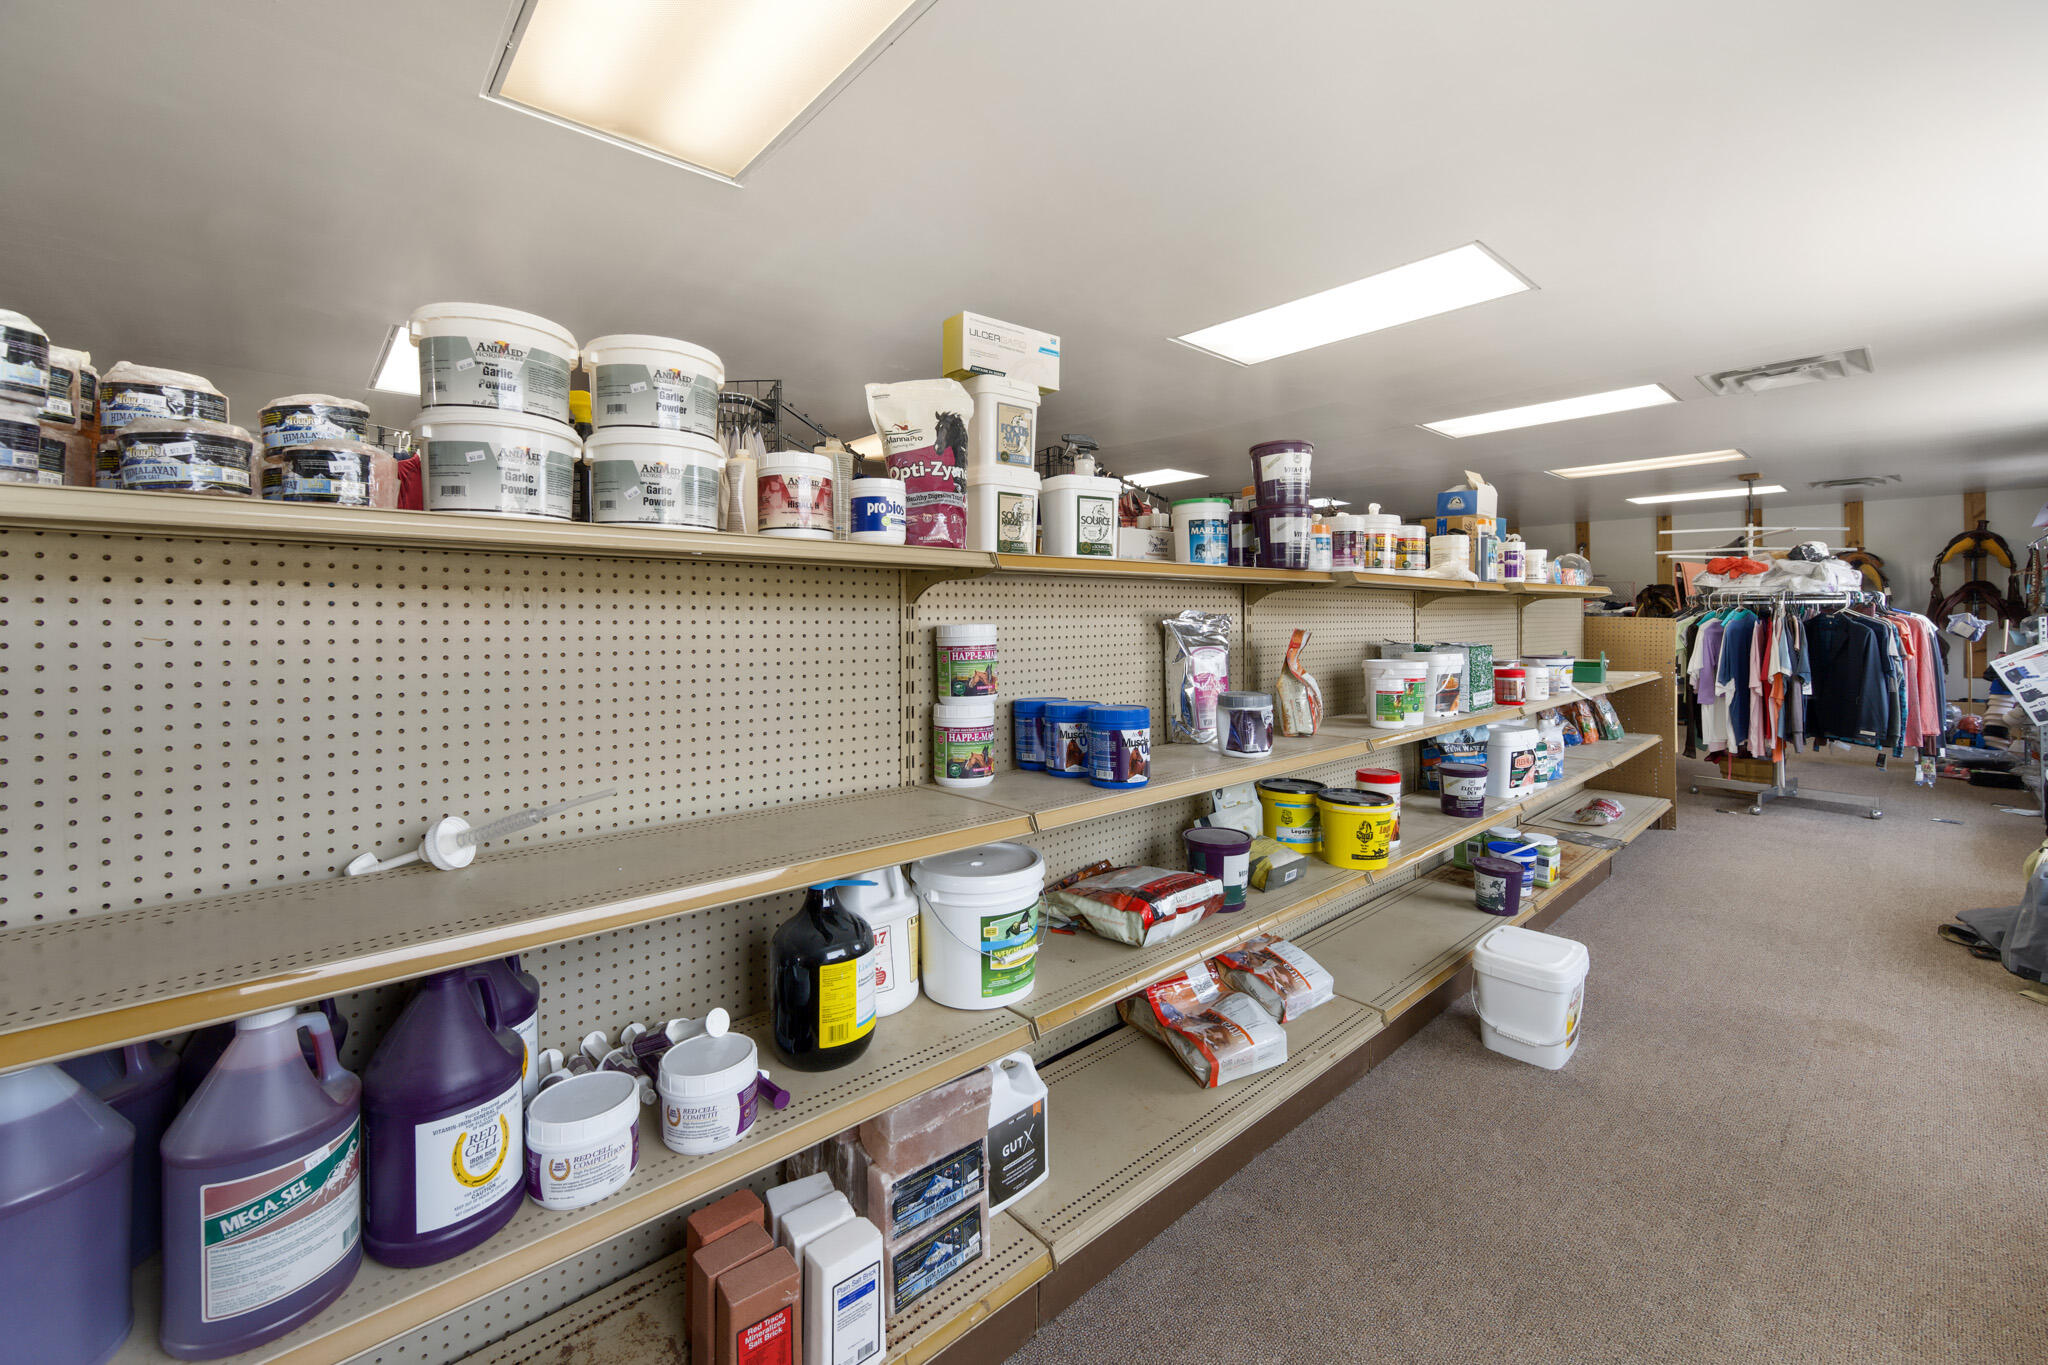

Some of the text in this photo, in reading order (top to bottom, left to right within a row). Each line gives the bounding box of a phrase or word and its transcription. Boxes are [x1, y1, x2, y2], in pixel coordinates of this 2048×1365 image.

[482, 366, 514, 379] Garlic
[478, 378, 518, 393] Powder
[659, 390, 685, 403] Garlic
[656, 402, 688, 415] Powder
[124, 465, 178, 479] HIMALAYAN
[504, 471, 534, 484] Garlic
[500, 483, 538, 497] Powder
[646, 485, 673, 496] Garlic
[642, 496, 676, 508] Powder
[867, 501, 905, 517] probios
[1080, 515, 1112, 526] SOURCE
[1190, 526, 1216, 536] MARE
[951, 650, 997, 661] HAPP-E-MA
[948, 730, 994, 743] HAPP-E-MA
[1059, 729, 1086, 740] Muscl
[1290, 828, 1311, 836] Legacy
[682, 1105, 718, 1115] RED CELL
[682, 1111, 719, 1121] COMPETIT
[468, 1124, 498, 1147] RED
[464, 1135, 500, 1159] CELL
[573, 1143, 613, 1163] RED CELL
[1002, 1135, 1023, 1158] GUT
[469, 1147, 497, 1165] IRON RICH
[573, 1141, 626, 1170] COMPETITION
[471, 1182, 496, 1200] CAUTION
[219, 1179, 312, 1236] MEGA-SEL
[836, 1268, 877, 1296] Plain Salt Brick
[744, 1316, 786, 1345] Mineralized
[747, 1312, 784, 1336] Red Trace
[748, 1327, 783, 1350] Salt Brick
